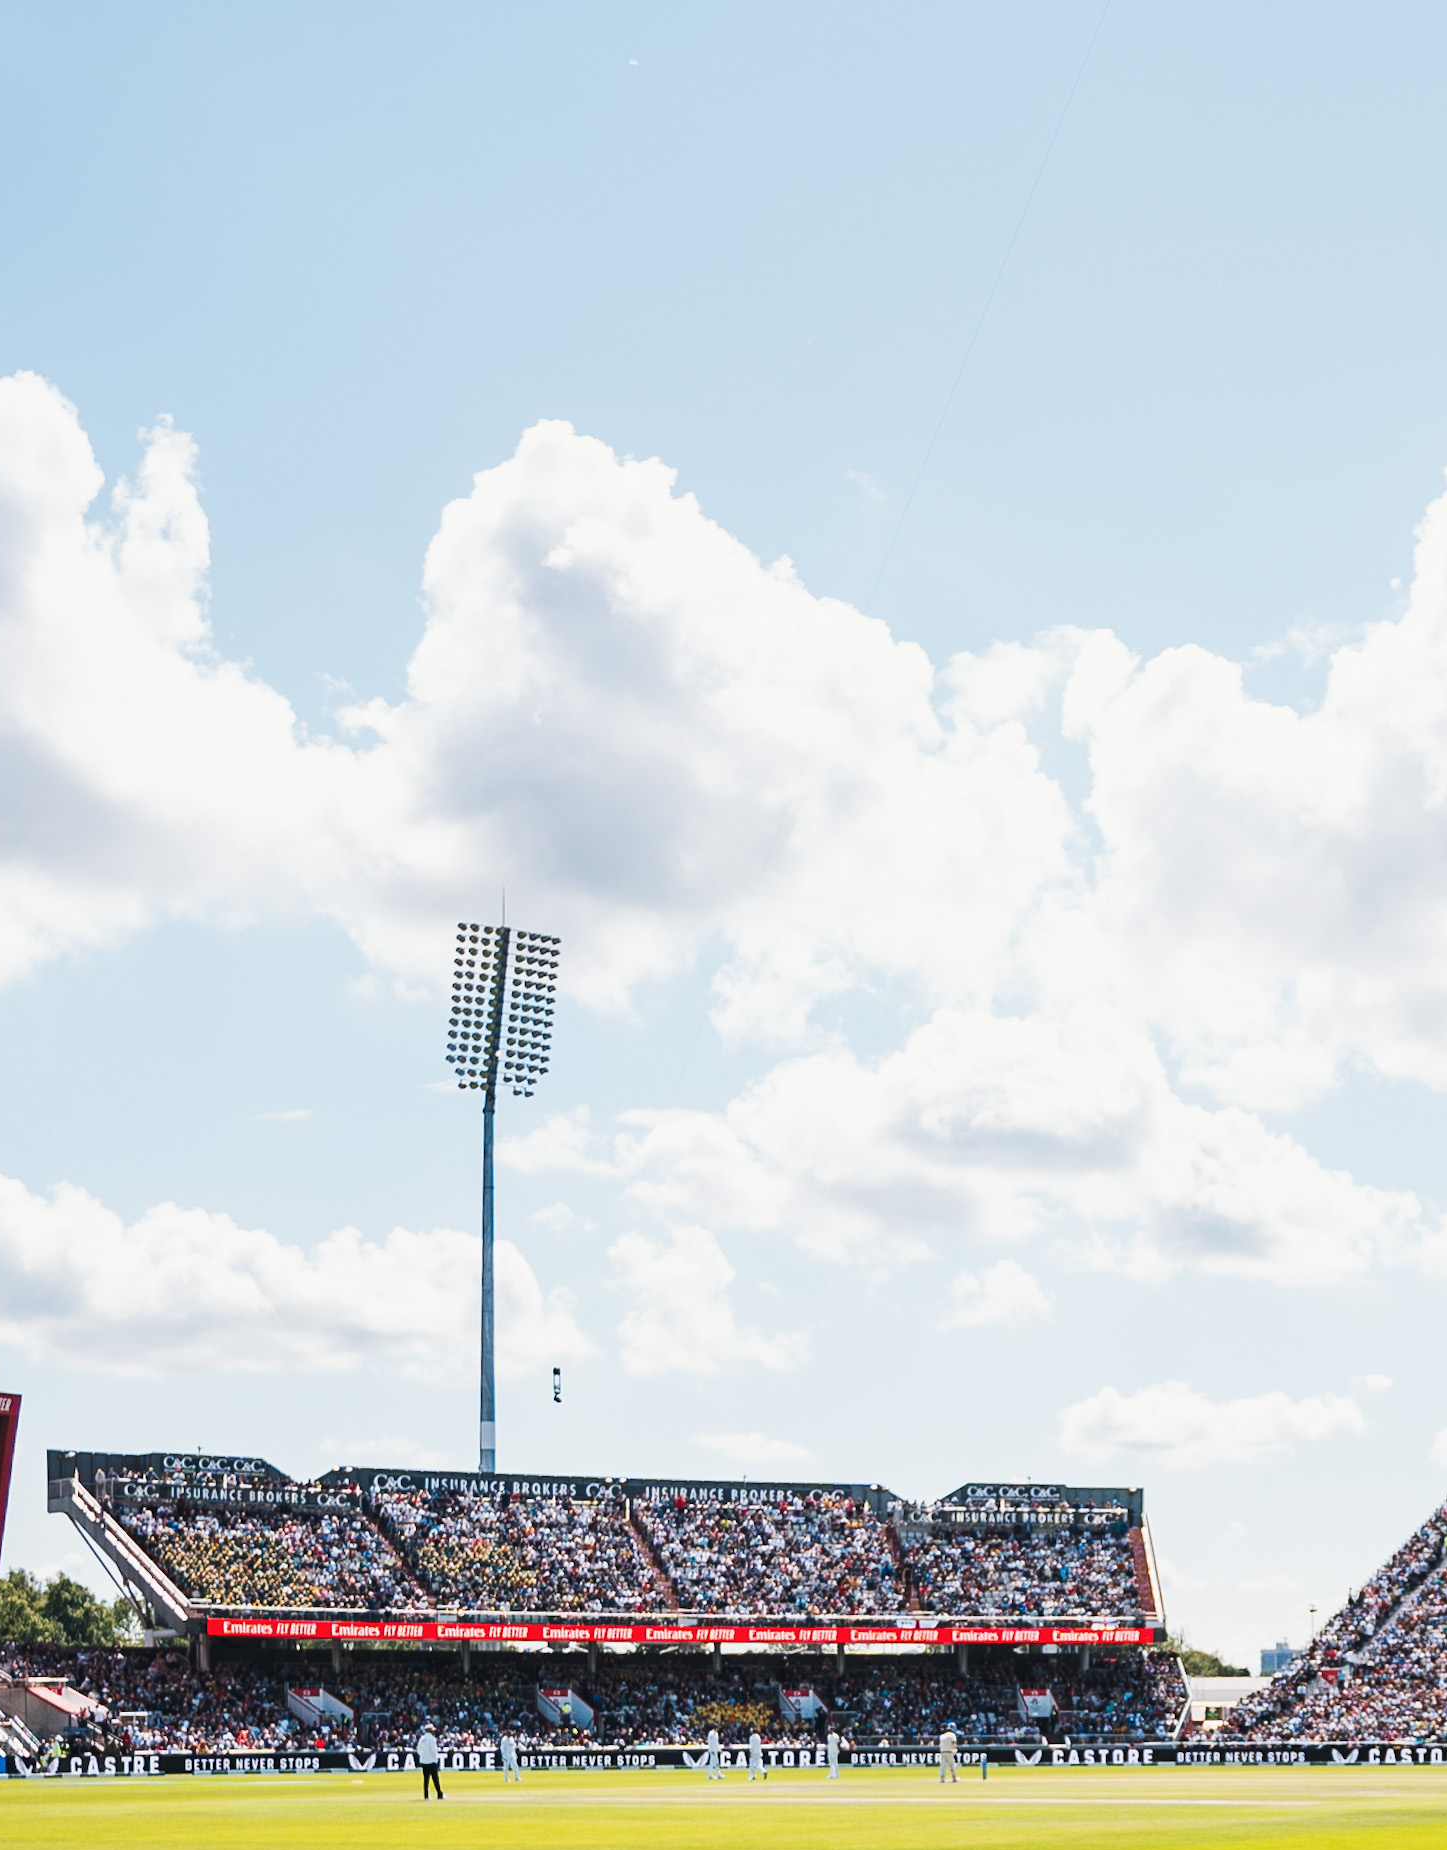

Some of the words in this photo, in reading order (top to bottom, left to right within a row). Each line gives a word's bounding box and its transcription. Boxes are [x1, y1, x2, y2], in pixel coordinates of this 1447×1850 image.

[170, 1486, 243, 1501] INSURANCE
[249, 1489, 307, 1505] BROKERS
[513, 1480, 577, 1498] BROKERS
[731, 1488, 794, 1503] BROKERS
[952, 1512, 1017, 1524] INSURANCE
[223, 1621, 273, 1635] Emirates
[276, 1622, 289, 1635] FLY
[437, 1624, 486, 1638] Emirates
[489, 1625, 501, 1638] FLY
[645, 1627, 694, 1641] Emirates
[696, 1628, 708, 1640] FLY
[1053, 1629, 1100, 1642] Emirates
[1102, 1630, 1113, 1642] FLY
[386, 1752, 497, 1771] CATORE
[520, 1754, 567, 1768] BETTER
[571, 1754, 612, 1768] NEVER
[616, 1753, 656, 1767] STOPS
[850, 1752, 897, 1765] BETTER
[902, 1752, 942, 1765] NEVER
[1051, 1748, 1154, 1765] CASTORE
[1176, 1751, 1221, 1763] BETTER
[1225, 1751, 1263, 1763] NEVER
[1267, 1751, 1307, 1763] STOPS
[184, 1757, 230, 1772] BETTER
[235, 1757, 275, 1771] NEVER
[279, 1756, 320, 1770] STOPS
